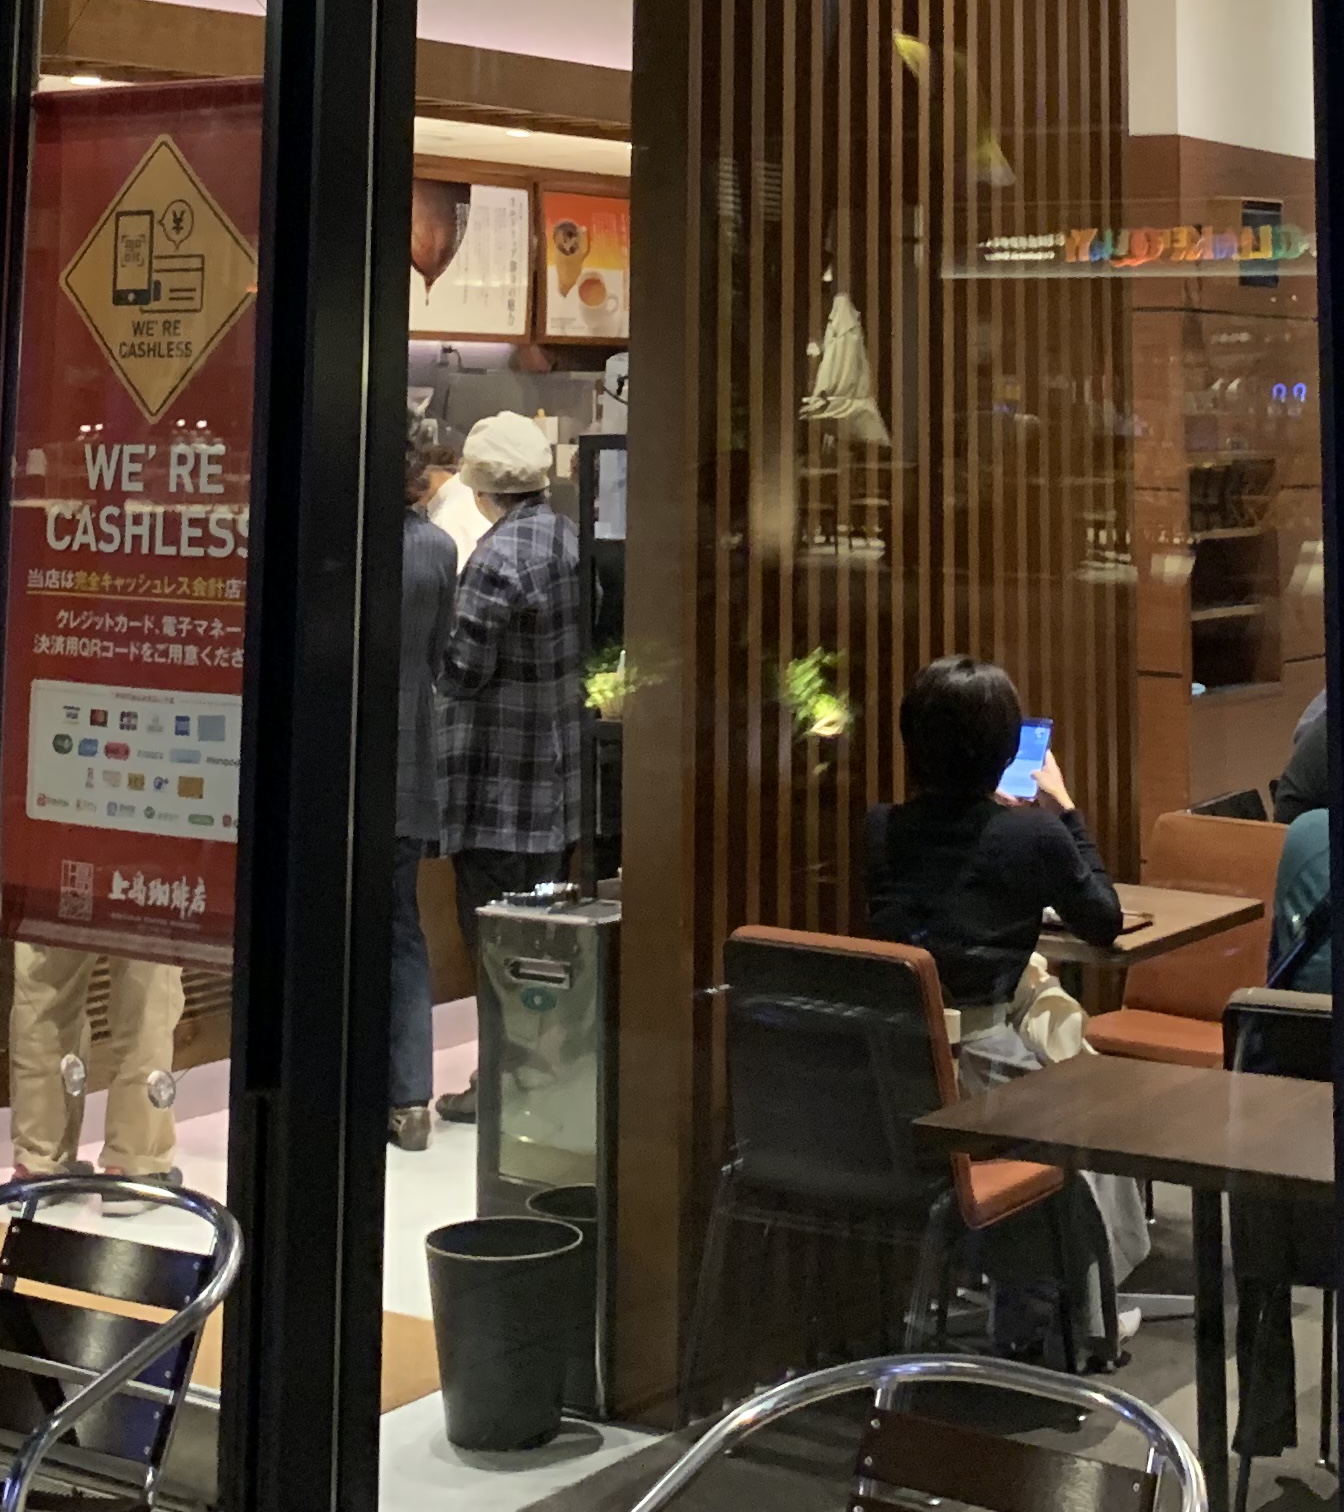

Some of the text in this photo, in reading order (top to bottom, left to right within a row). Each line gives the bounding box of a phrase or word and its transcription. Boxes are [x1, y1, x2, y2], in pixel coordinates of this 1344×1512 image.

[118, 340, 193, 359] CASHLESS
[27, 568, 247, 600] 当店は完全キャッシュレス会計店
